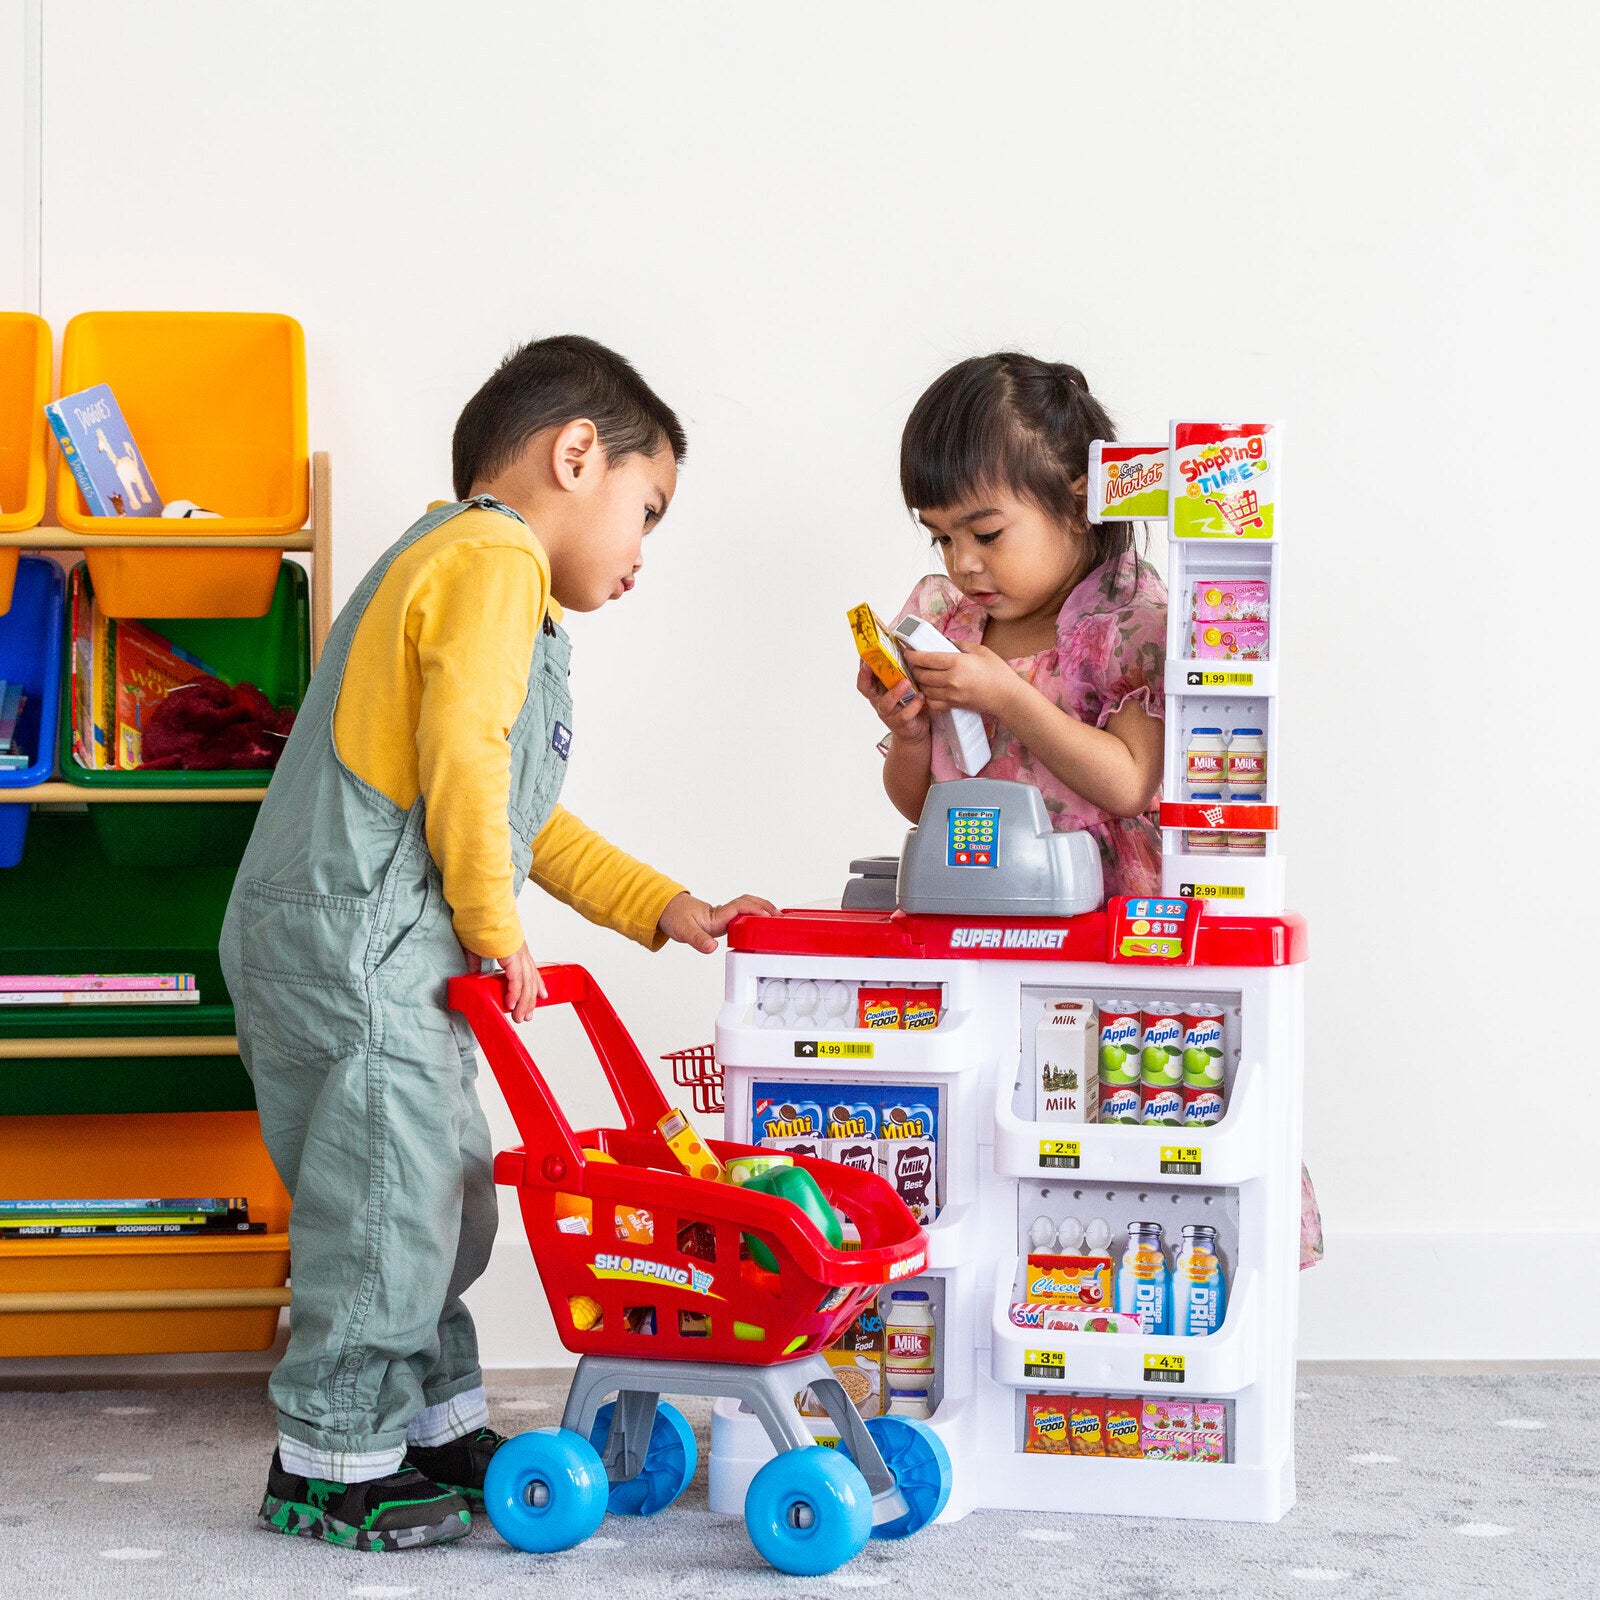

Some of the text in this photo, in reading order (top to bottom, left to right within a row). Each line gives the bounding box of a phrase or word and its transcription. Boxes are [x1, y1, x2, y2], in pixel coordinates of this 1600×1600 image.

[74, 398, 111, 435] DOGGIES
[1179, 437, 1264, 483] Shopping
[70, 459, 95, 498] DOGGIES
[1106, 463, 1164, 504] Market
[1198, 462, 1254, 494] TIME
[1234, 586, 1265, 594] Lollipops
[1233, 625, 1265, 633] Lollipops
[1204, 675, 1225, 683] 1.99
[1194, 757, 1217, 769] Milk
[1234, 758, 1258, 770] Milk
[1195, 886, 1217, 896] 2.99
[1166, 904, 1182, 914] 25
[1163, 922, 1178, 934] 10
[950, 928, 1069, 949] SUPER MARKET
[1161, 943, 1169, 954] 5
[866, 1009, 897, 1021] Cookies
[871, 1015, 898, 1028] FOOD
[903, 1010, 934, 1022] Cookies
[1052, 1016, 1077, 1025] Milk
[908, 1016, 936, 1029] FOOD
[1102, 1026, 1137, 1042] Apple
[1144, 1027, 1179, 1044] Apple
[1185, 1029, 1221, 1045] Apple
[819, 1045, 841, 1055] 4.99
[1046, 1097, 1076, 1111] Milk
[1102, 1098, 1137, 1115] Apple
[1144, 1100, 1179, 1117] Apple
[1185, 1102, 1220, 1118] Apple
[766, 1116, 812, 1138] Mini
[827, 1118, 865, 1139] Mini
[881, 1120, 922, 1139] Mini
[845, 1158, 867, 1172] Milk
[901, 1160, 924, 1174] Milk
[904, 1180, 923, 1190] Best
[116, 1225, 162, 1233] GOODNIGHT
[163, 1224, 181, 1232] BOB
[594, 1254, 689, 1285] SHOPPING
[889, 1252, 925, 1280] SHOPPING
[1031, 1278, 1081, 1294] Cheese
[1155, 1286, 1163, 1324] orange
[1209, 1290, 1217, 1328] orange
[854, 1340, 874, 1351] Food
[895, 1335, 922, 1350] Milk
[1160, 1357, 1183, 1368] 4.70
[1035, 1415, 1063, 1425] Cookies
[1069, 1417, 1098, 1427] Cookies
[1107, 1419, 1136, 1430] Cookies
[1040, 1421, 1065, 1433] FOOD
[1074, 1423, 1100, 1434] FOOD
[1112, 1425, 1137, 1437] FOOD
